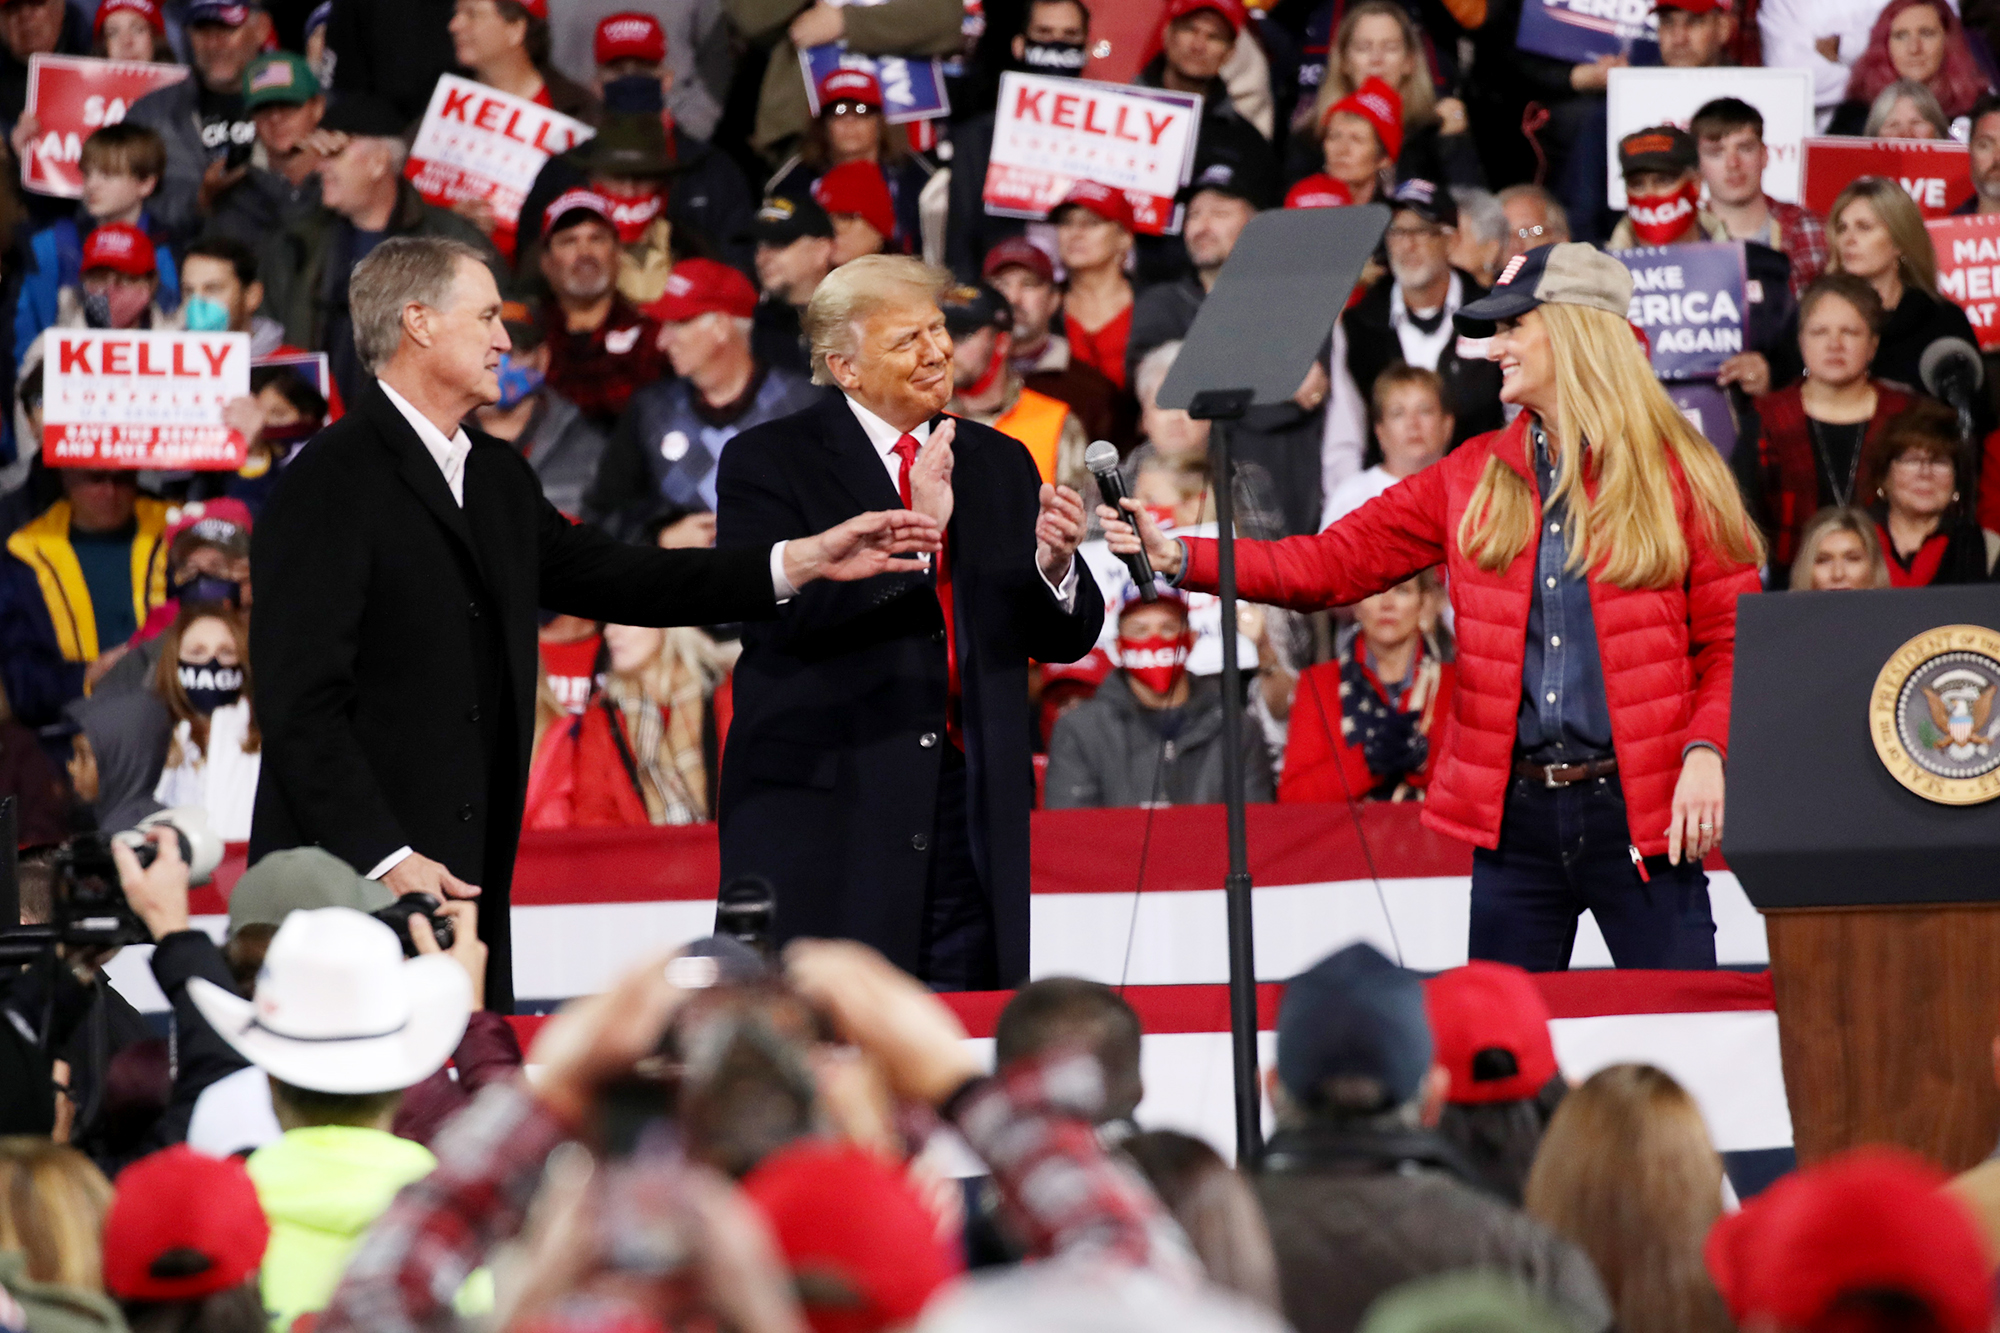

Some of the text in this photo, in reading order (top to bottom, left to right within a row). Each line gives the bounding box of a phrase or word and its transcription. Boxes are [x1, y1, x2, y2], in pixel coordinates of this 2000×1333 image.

[1013, 87, 1174, 145] KELLY
[1631, 265, 1685, 291] AKE
[1627, 290, 1742, 326] ERICA
[60, 339, 232, 377] KELLY
[1656, 328, 1743, 353] AGAIN
